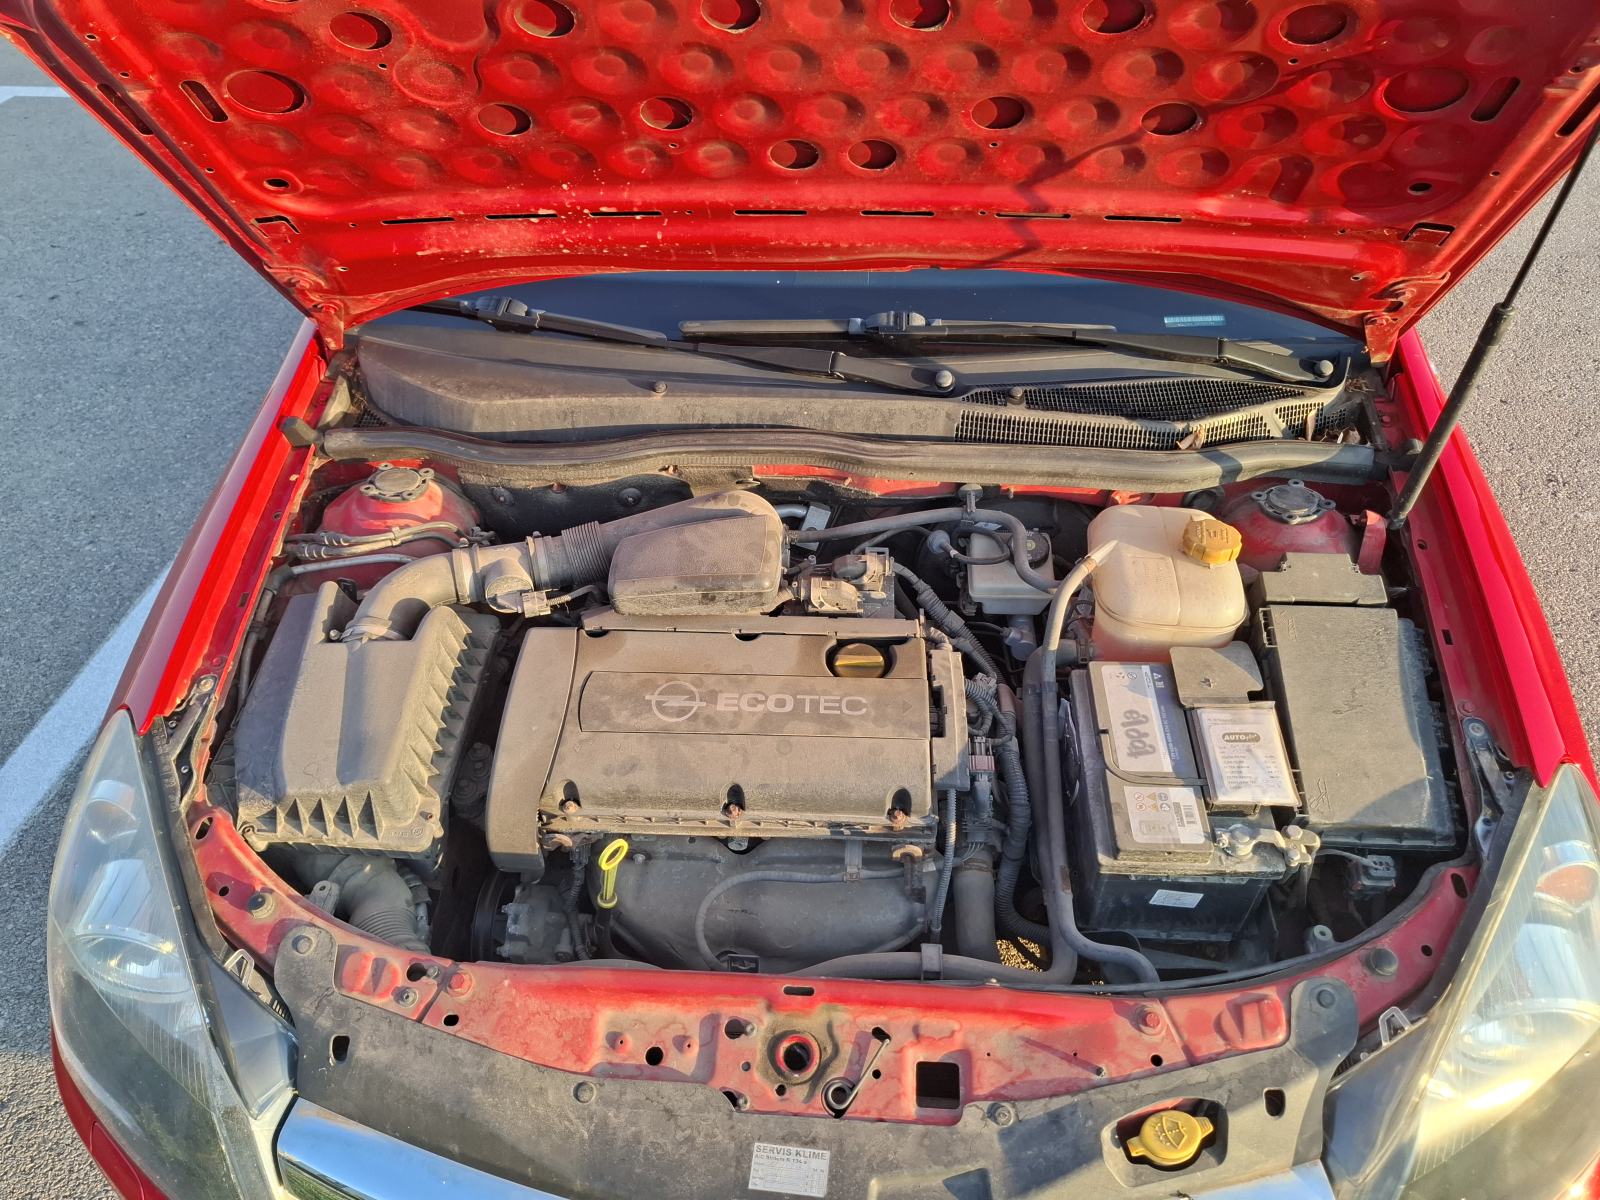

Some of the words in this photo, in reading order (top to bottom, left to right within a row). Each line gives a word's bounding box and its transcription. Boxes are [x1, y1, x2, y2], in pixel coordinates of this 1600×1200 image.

[716, 692, 868, 716] ECOTEC
[1120, 709, 1156, 759] topla
[755, 1144, 792, 1156] SERVIS
[795, 1149, 828, 1160] KLIME
